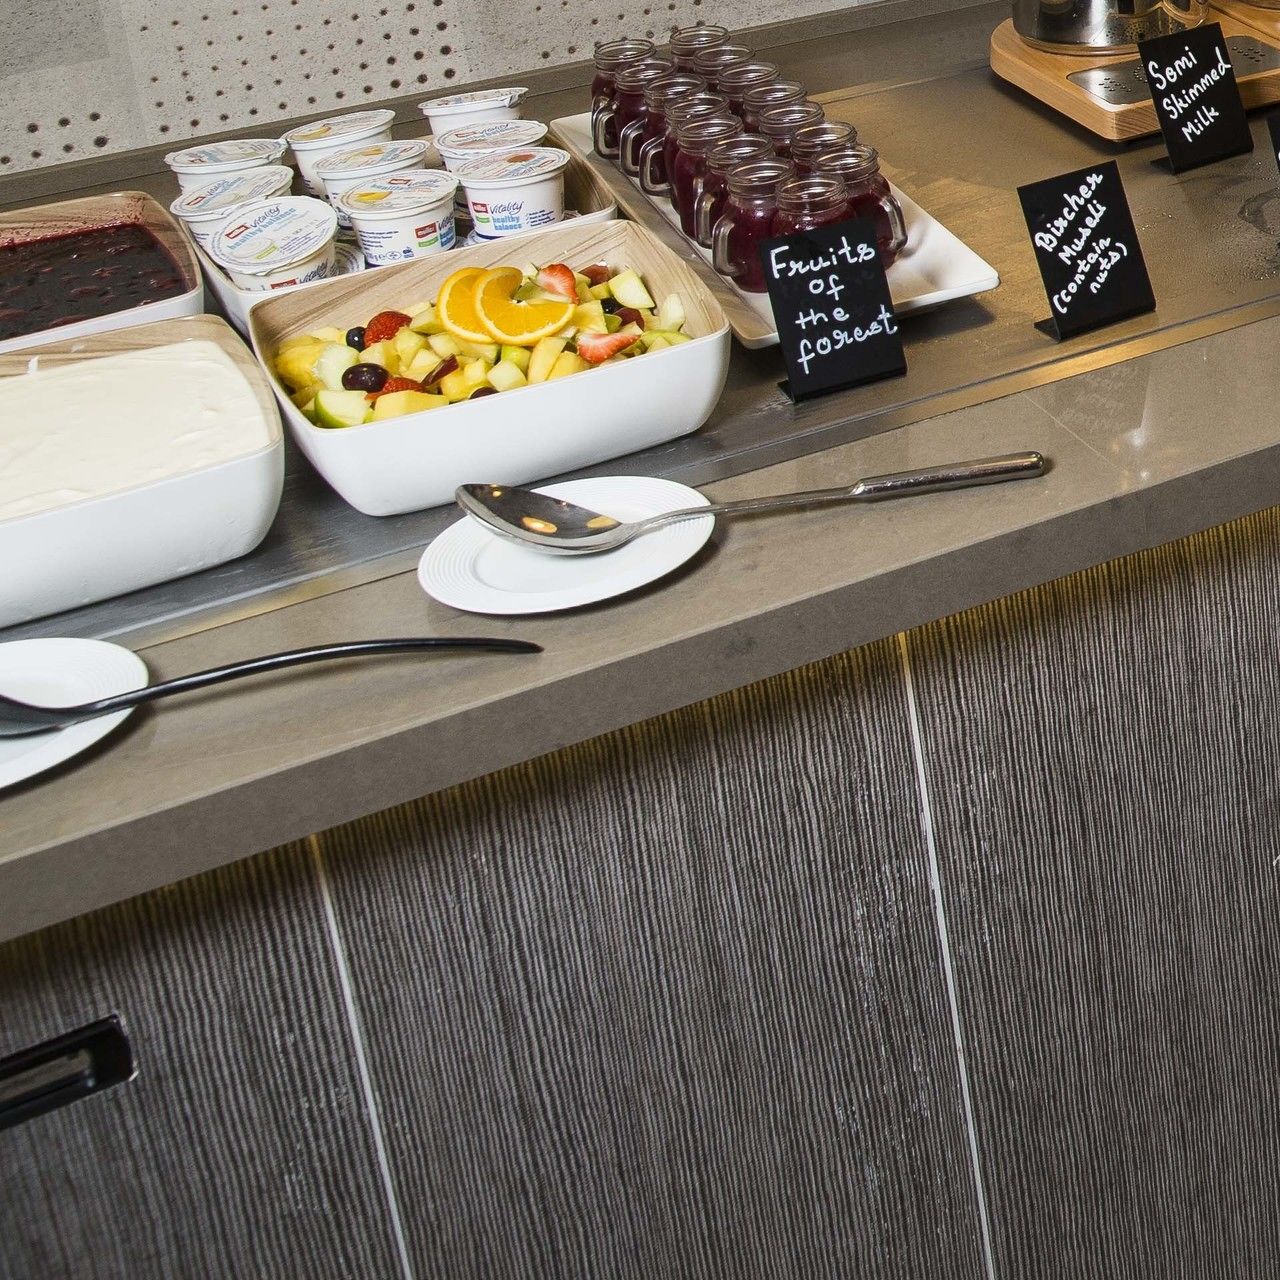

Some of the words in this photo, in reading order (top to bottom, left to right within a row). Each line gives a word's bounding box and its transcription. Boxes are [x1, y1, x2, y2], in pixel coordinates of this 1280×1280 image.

[1162, 46, 1232, 120] Skimmed
[1181, 105, 1219, 143] Milk
[490, 201, 524, 215] Vitality
[771, 236, 875, 278] Fruits
[1090, 242, 1127, 294] nuts)
[809, 274, 845, 301] of
[795, 307, 850, 329] the
[797, 304, 898, 375] forest
